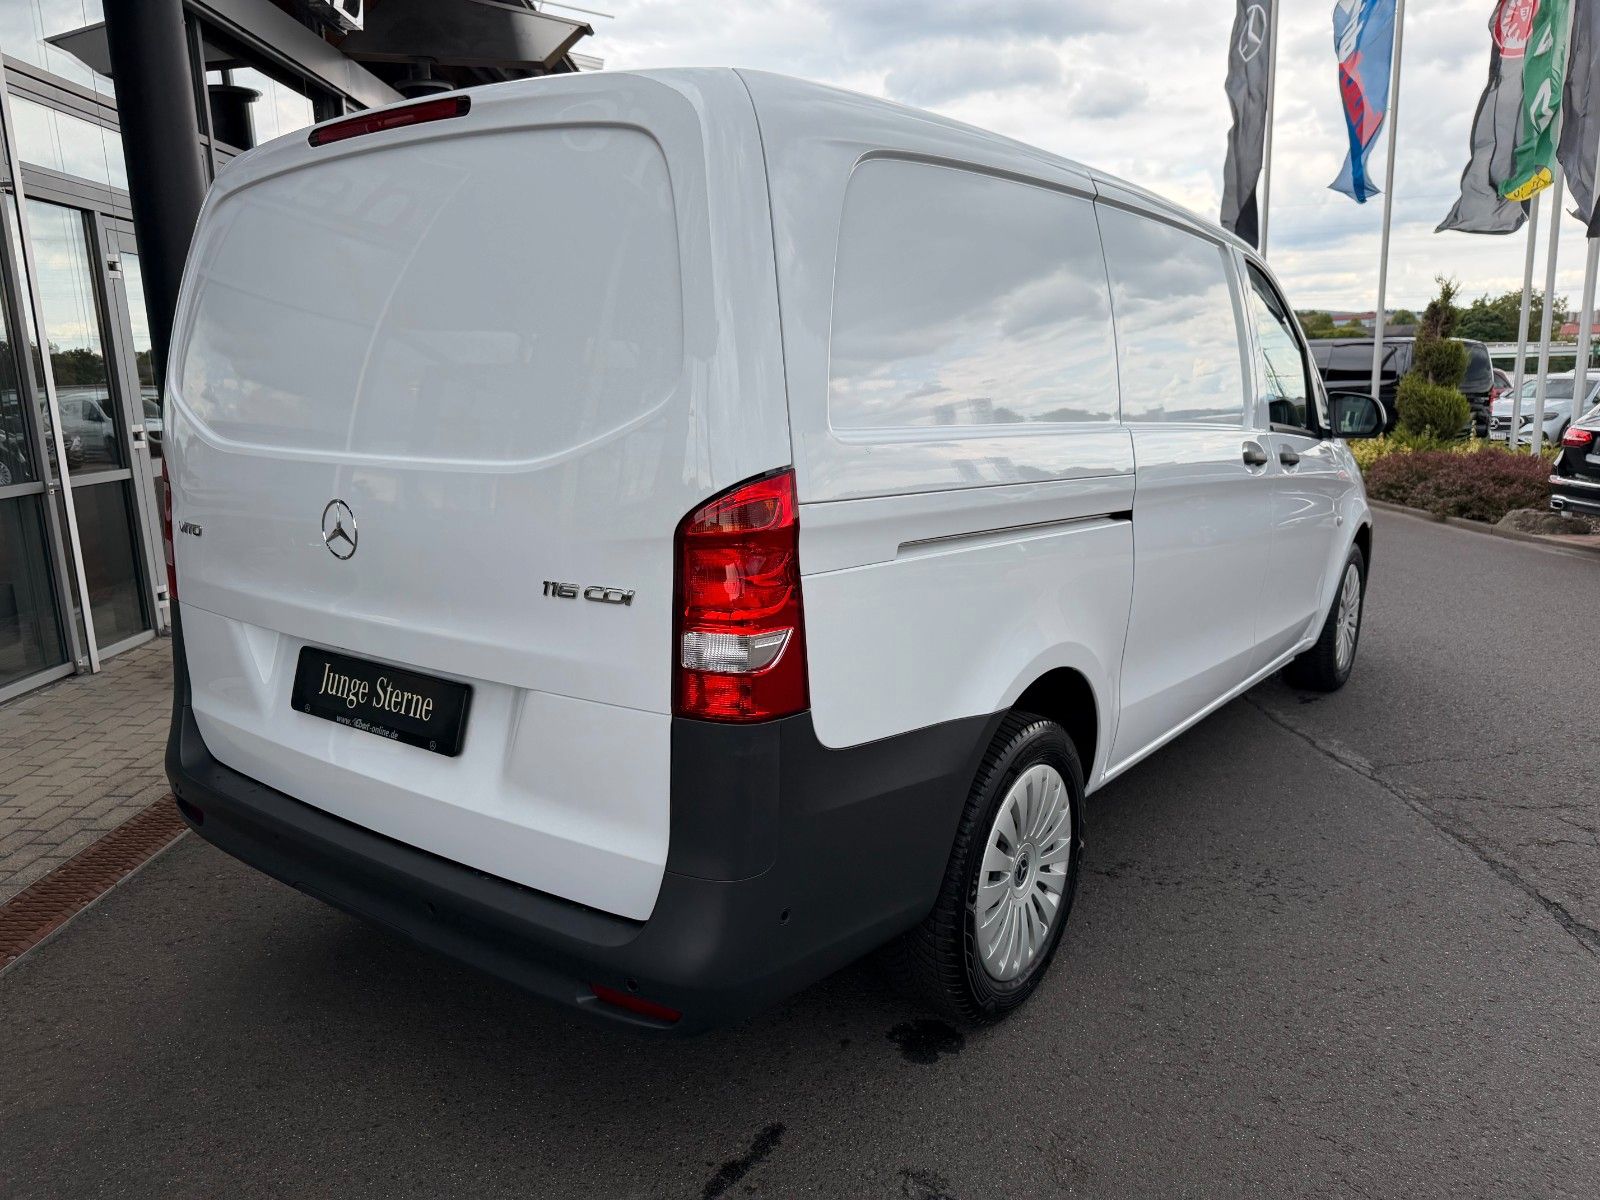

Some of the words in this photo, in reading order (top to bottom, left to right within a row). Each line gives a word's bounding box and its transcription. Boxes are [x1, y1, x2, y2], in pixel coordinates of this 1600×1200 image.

[178, 520, 203, 537] VITO
[542, 580, 580, 600] 116
[583, 585, 636, 607] CDI
[318, 662, 369, 709] Junge
[372, 676, 434, 721] Sterne
